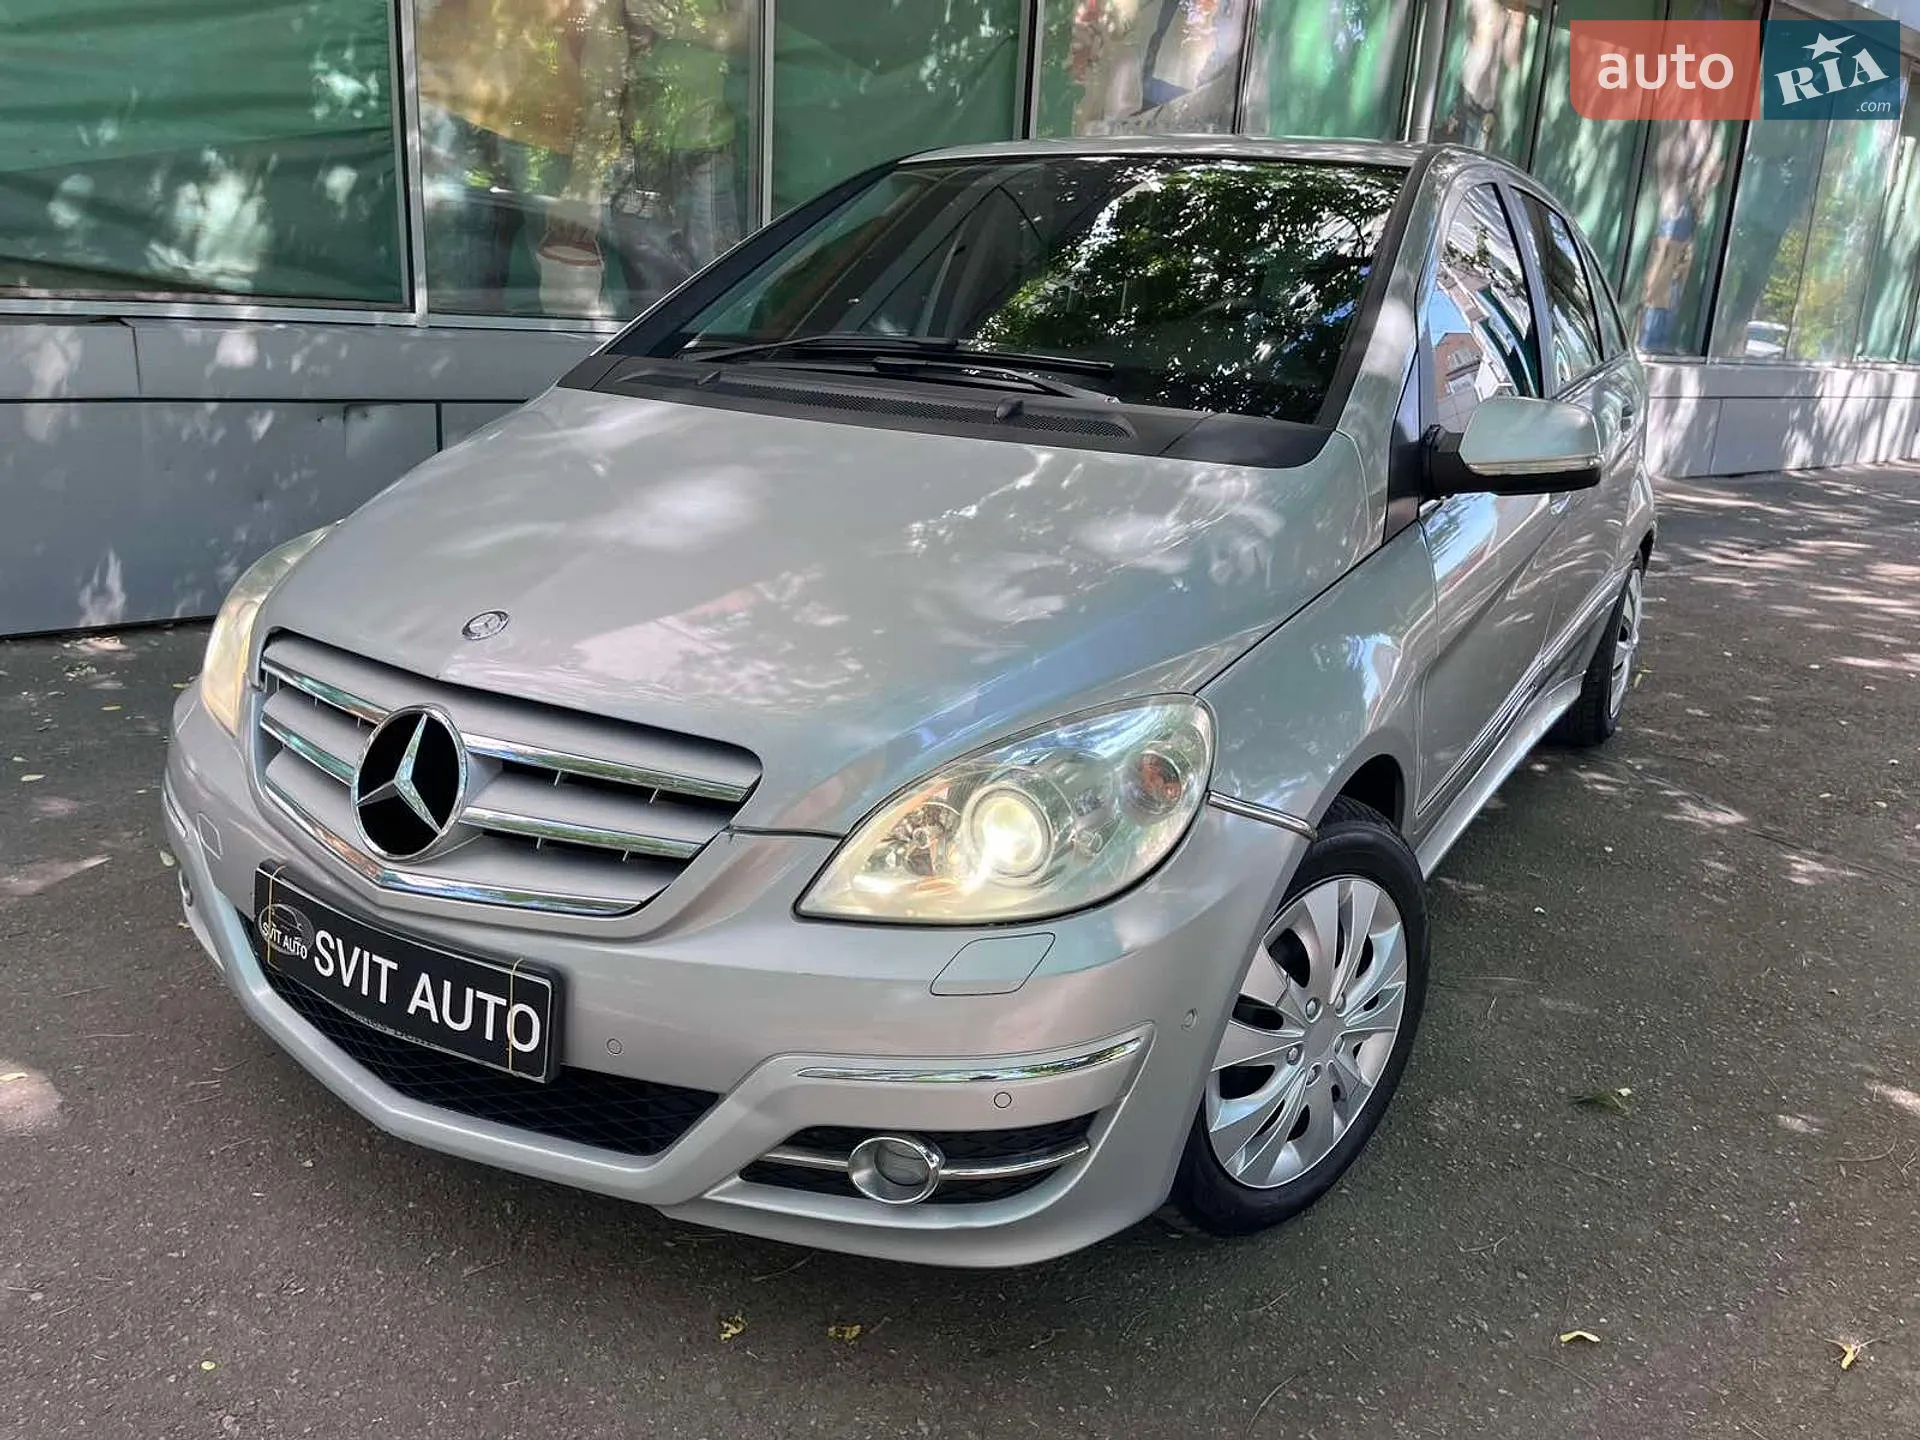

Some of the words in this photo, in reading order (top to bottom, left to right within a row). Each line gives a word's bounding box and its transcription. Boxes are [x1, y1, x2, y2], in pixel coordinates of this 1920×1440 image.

[283, 935, 308, 960] AUTO
[314, 930, 399, 1004] SVIT
[407, 972, 541, 1053] AUTO
